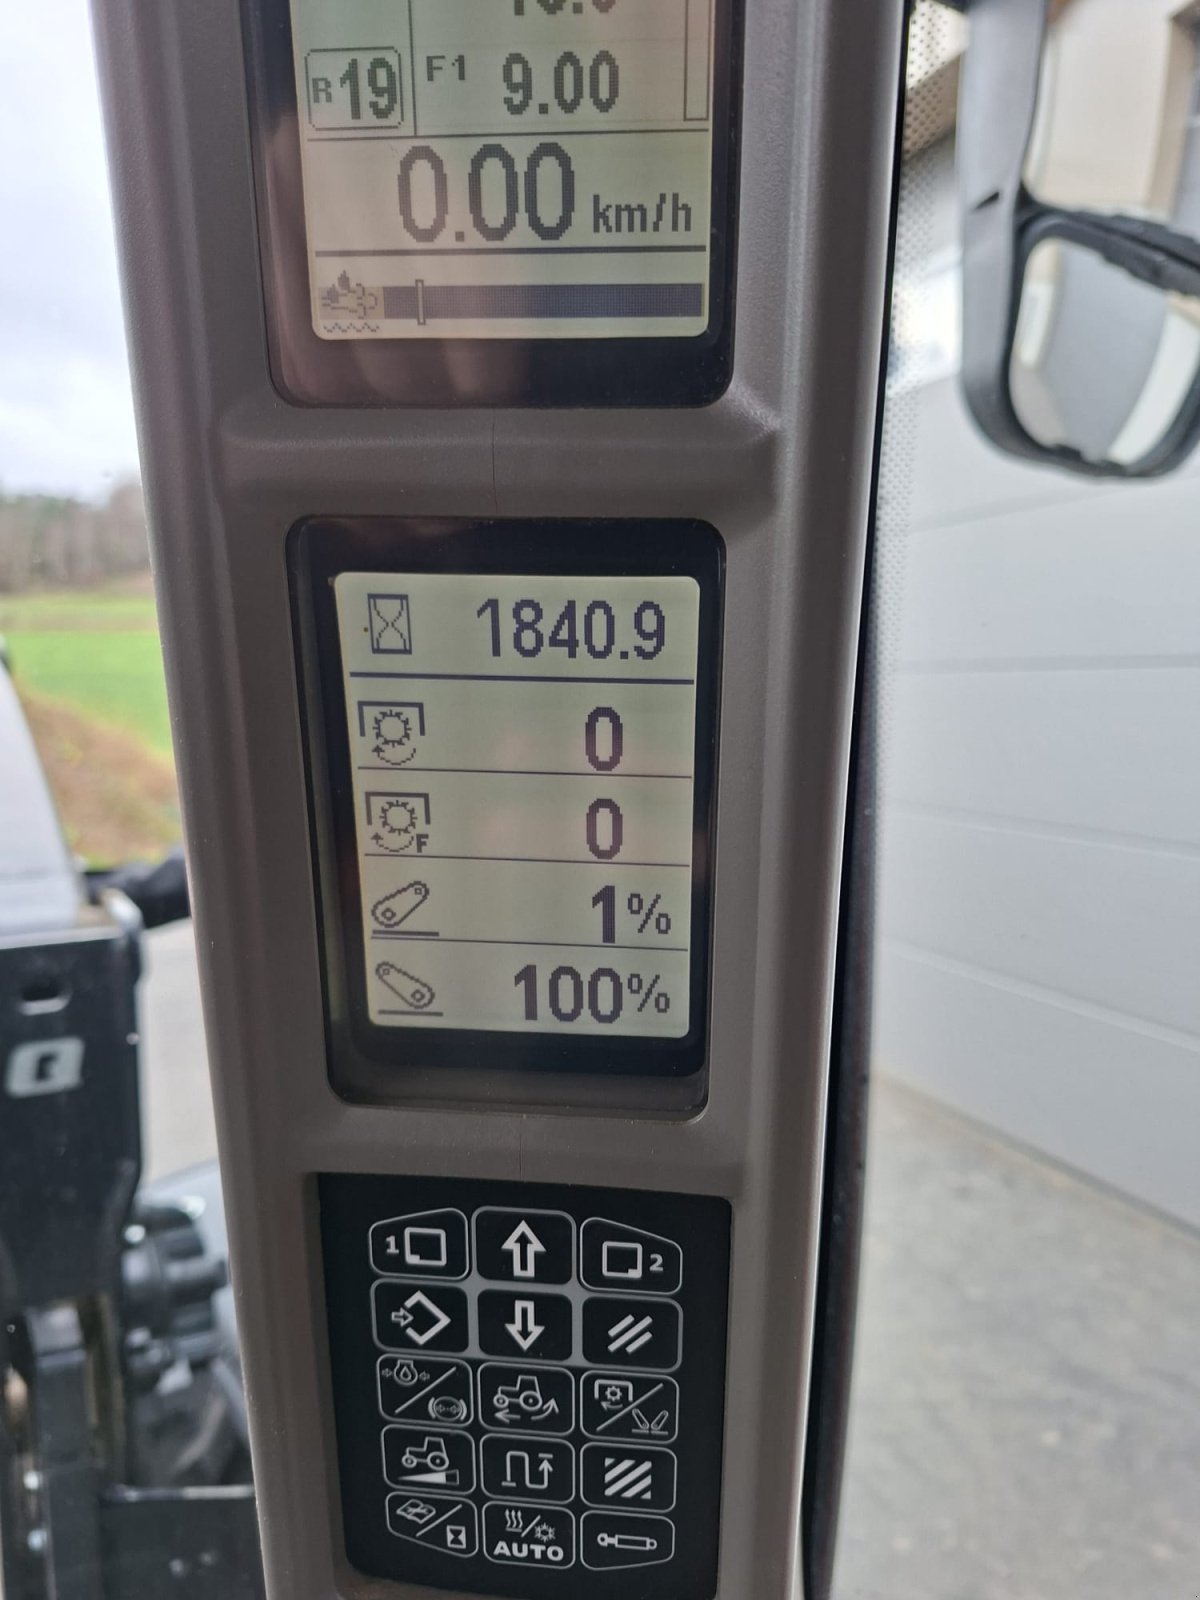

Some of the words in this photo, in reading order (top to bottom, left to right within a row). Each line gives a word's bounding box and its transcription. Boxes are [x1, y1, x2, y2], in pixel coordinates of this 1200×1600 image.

[426, 55, 466, 82] F1
[503, 50, 620, 115] 9.00
[397, 142, 575, 243] 0.00
[593, 193, 692, 233] km/h
[476, 598, 666, 660] 1840.9
[585, 706, 623, 771] 0
[415, 833, 429, 853] F
[586, 798, 623, 860] 0
[514, 964, 670, 1024] 100%
[385, 1235, 399, 1254] 1
[649, 1253, 664, 1272] 2
[493, 1541, 564, 1562] AUTO
